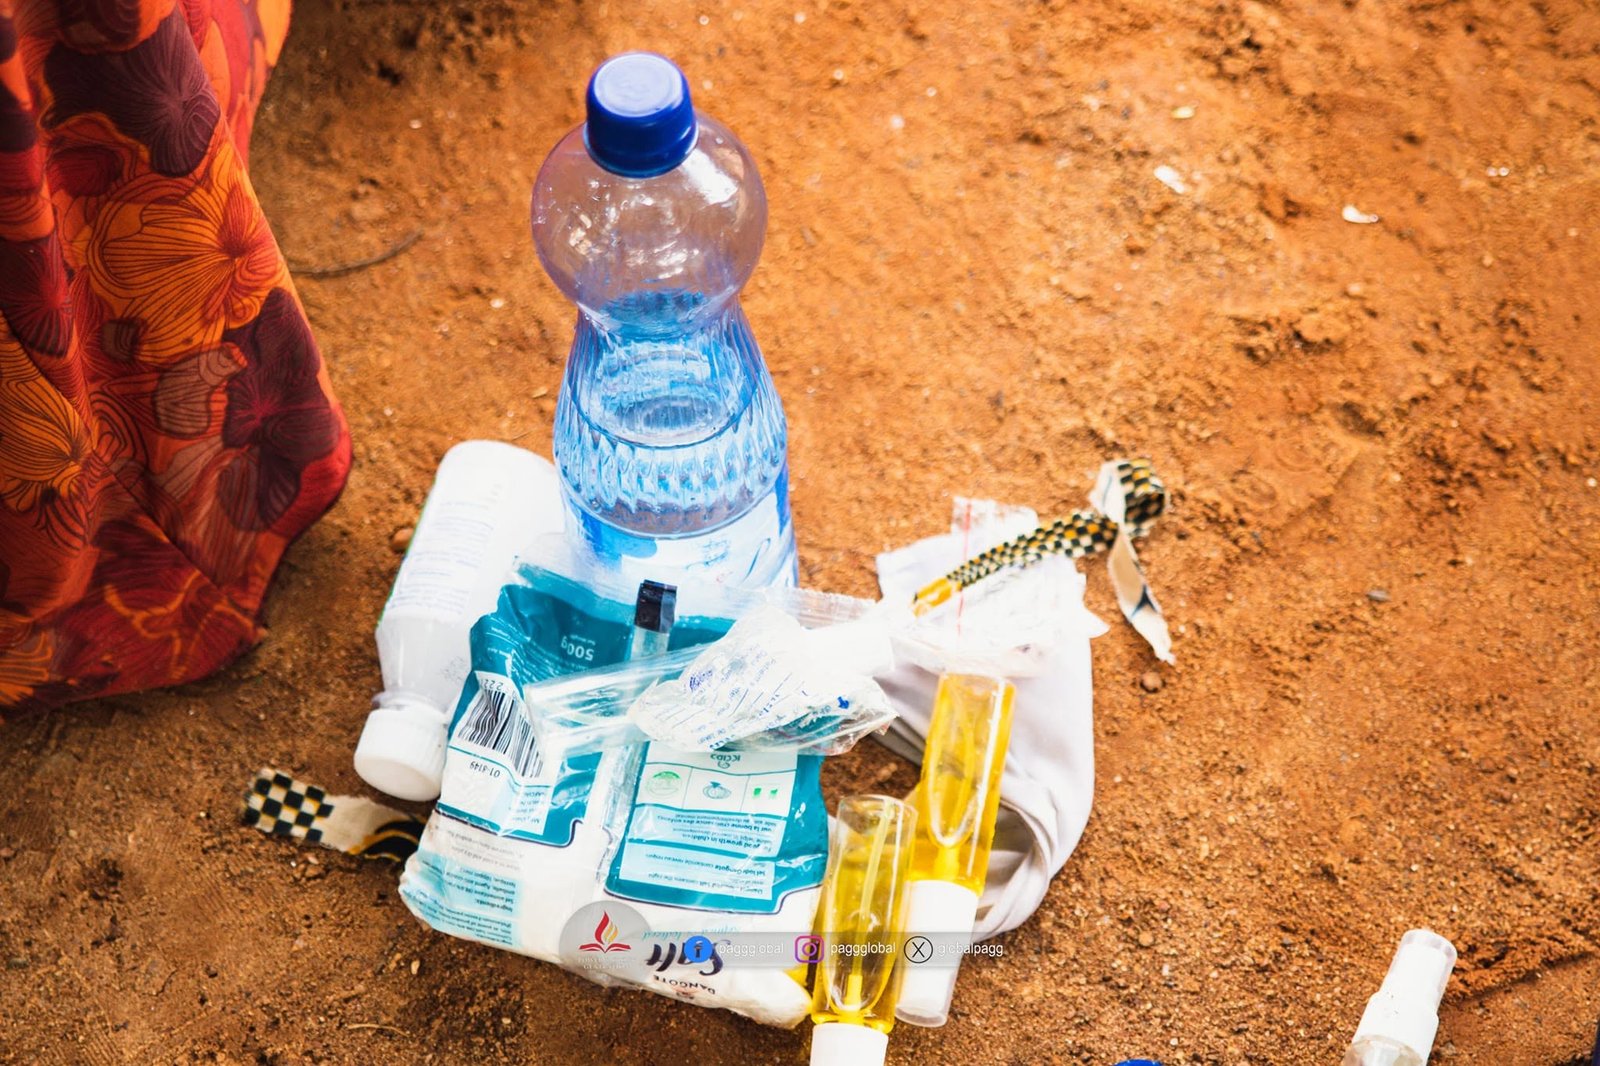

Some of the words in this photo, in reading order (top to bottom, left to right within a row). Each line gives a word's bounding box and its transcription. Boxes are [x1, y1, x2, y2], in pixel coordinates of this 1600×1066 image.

[560, 635, 594, 661] 500g
[730, 822, 752, 830] bonne
[717, 837, 742, 846] growth
[653, 974, 715, 994] DANGOTE
